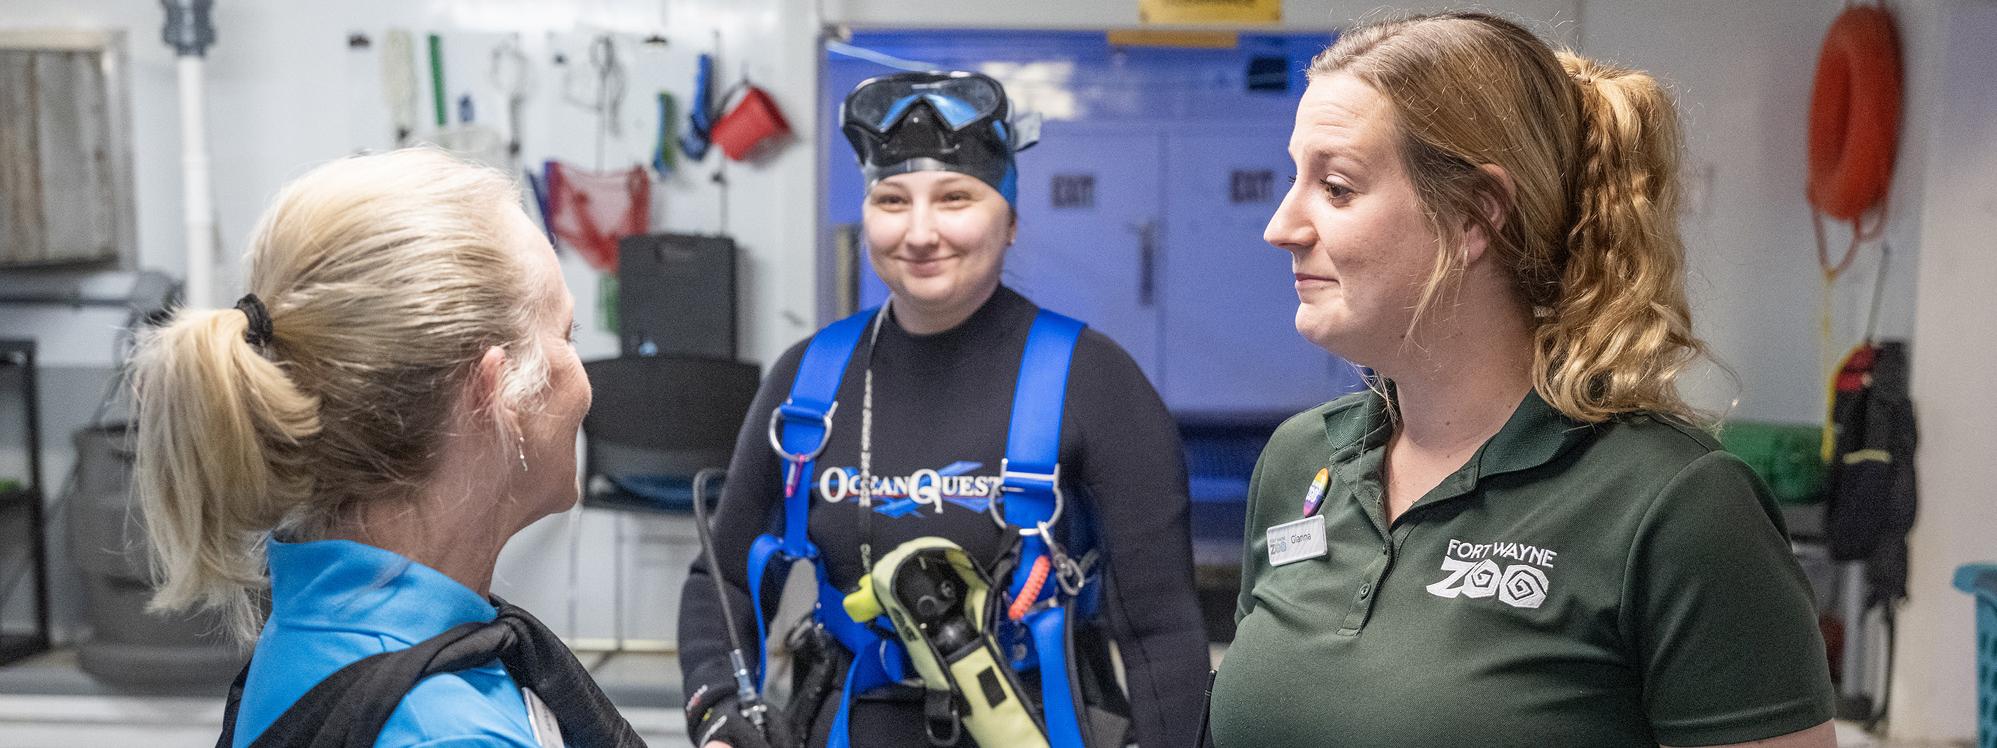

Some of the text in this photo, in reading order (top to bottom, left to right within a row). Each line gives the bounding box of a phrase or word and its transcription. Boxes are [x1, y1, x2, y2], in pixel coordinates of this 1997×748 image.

[1290, 532, 1312, 545] Gianna
[1446, 538, 1558, 569] FORT WAYNE
[1425, 555, 1550, 609] ZOO
